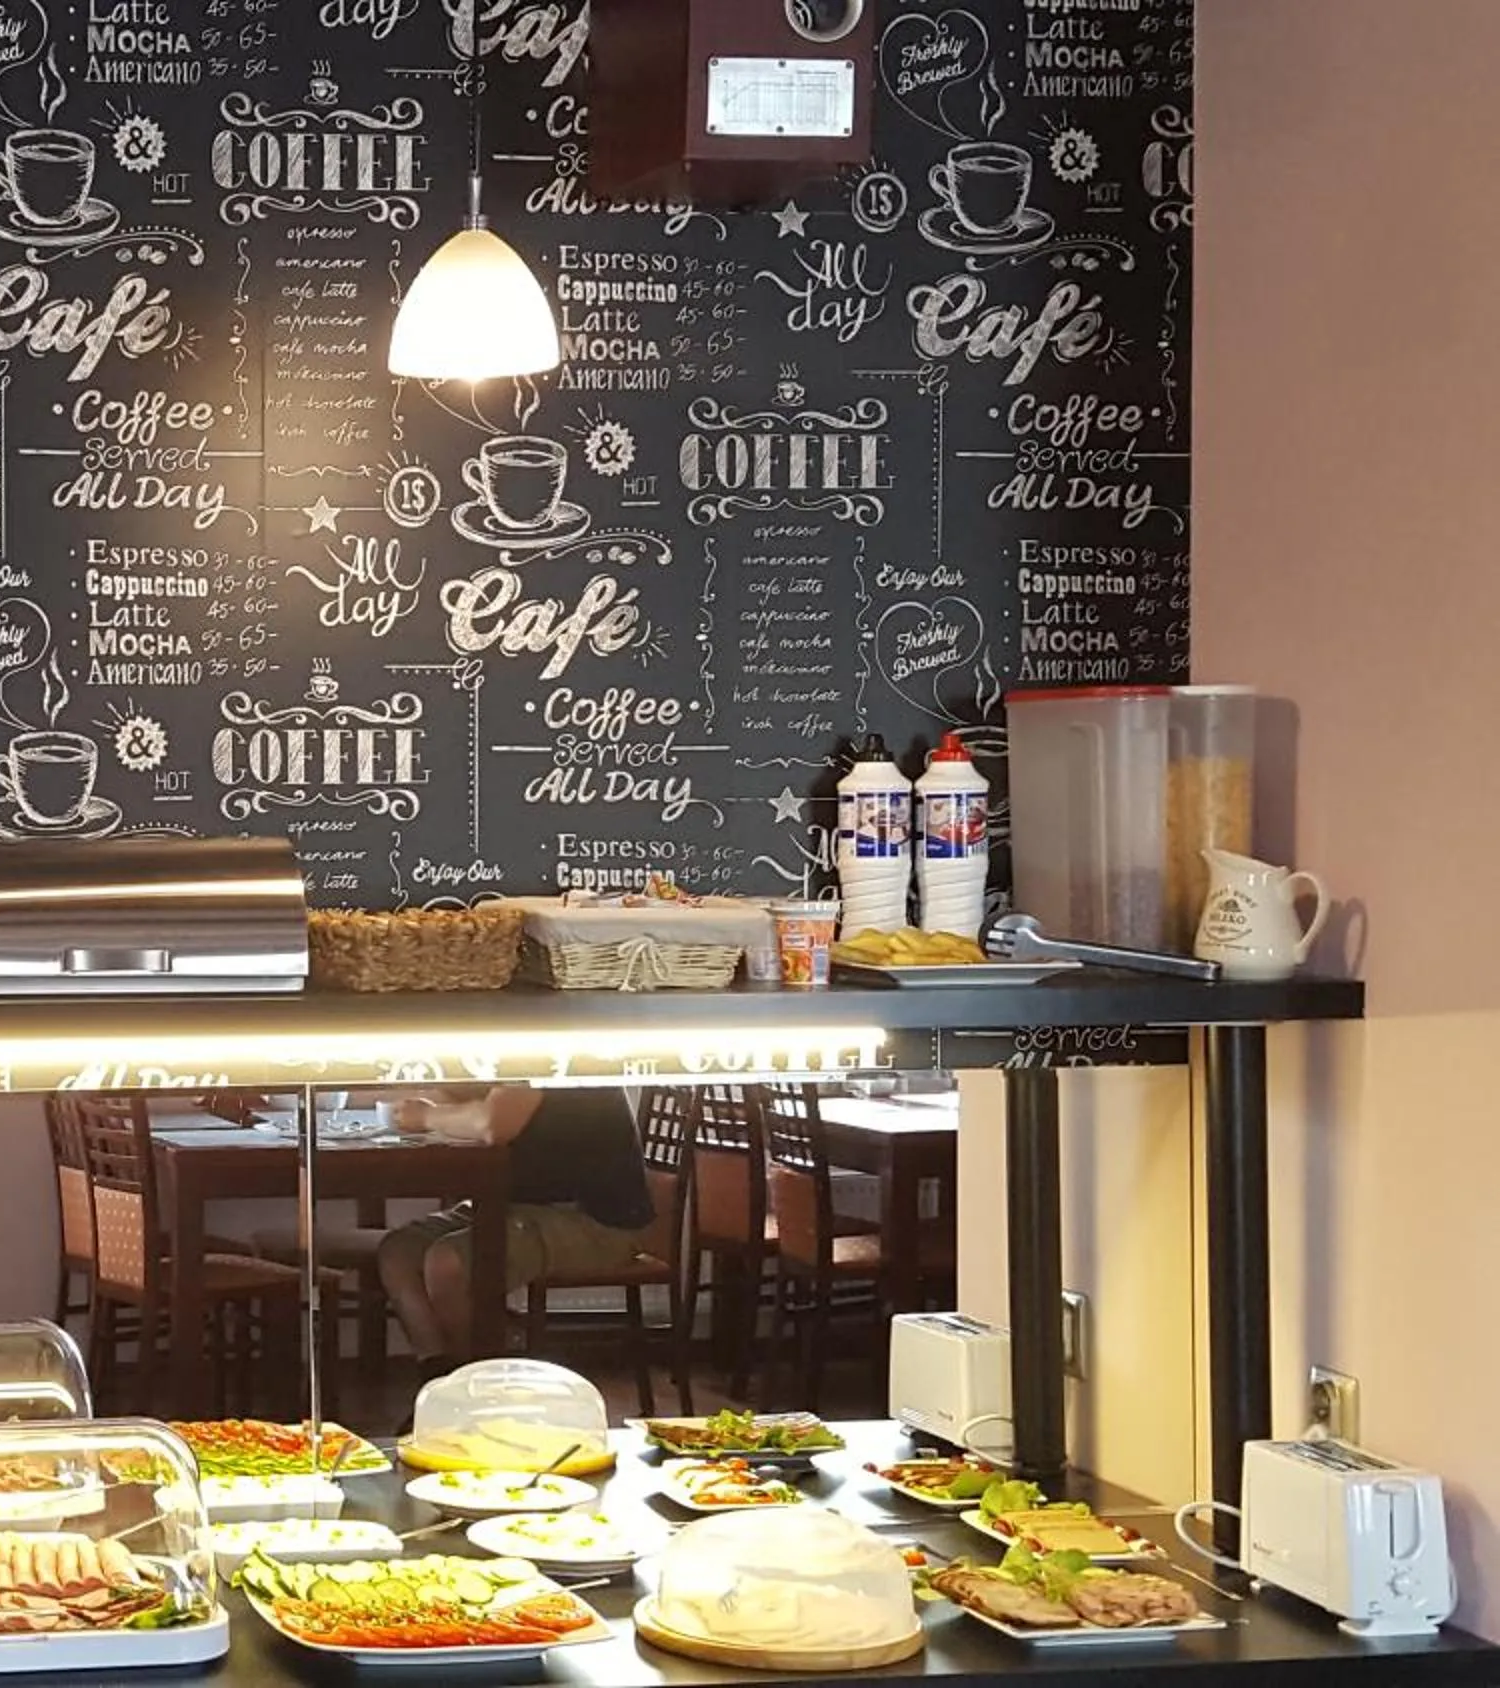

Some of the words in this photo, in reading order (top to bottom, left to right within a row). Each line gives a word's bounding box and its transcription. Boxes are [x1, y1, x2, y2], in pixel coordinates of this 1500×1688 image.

[902, 36, 969, 66] Freshly
[898, 59, 966, 93] Brewed
[212, 130, 430, 191] COFFEE
[153, 174, 190, 192] HOT
[557, 246, 678, 272] Espresso
[557, 273, 678, 302] Cappuccino
[561, 306, 641, 332] Latte
[906, 272, 1103, 386] Café
[557, 364, 671, 390] Americano
[73, 390, 214, 445] Coffee
[1007, 394, 1144, 448] Coffee
[82, 438, 210, 472] Served
[679, 433, 895, 491] COFFEE
[1017, 440, 1139, 473] Served
[53, 472, 127, 508] All
[134, 476, 225, 529] Day
[988, 476, 1059, 510] All
[1066, 480, 1154, 528] Day
[88, 540, 208, 567] Espresso
[1020, 540, 1136, 569] Espresso
[86, 569, 208, 599] Cappuccino
[876, 563, 929, 591] Enjoy
[929, 565, 966, 586] Our
[1018, 570, 1135, 599] Cappuccino
[89, 601, 170, 627] Latte
[441, 567, 641, 681] Café
[1022, 600, 1100, 625] Latte
[780, 636, 832, 648] mocha
[896, 623, 965, 656] Freshly
[86, 659, 201, 685] Americano
[893, 647, 962, 682] Brewed
[1017, 655, 1129, 682] Americano
[544, 687, 683, 740] Coffee
[787, 715, 834, 737] coffee
[212, 728, 430, 784] COFFEE
[553, 732, 678, 768] Served
[154, 771, 191, 791] HOT
[525, 768, 596, 804] All
[604, 771, 692, 822] Day
[558, 834, 676, 860] Espresso
